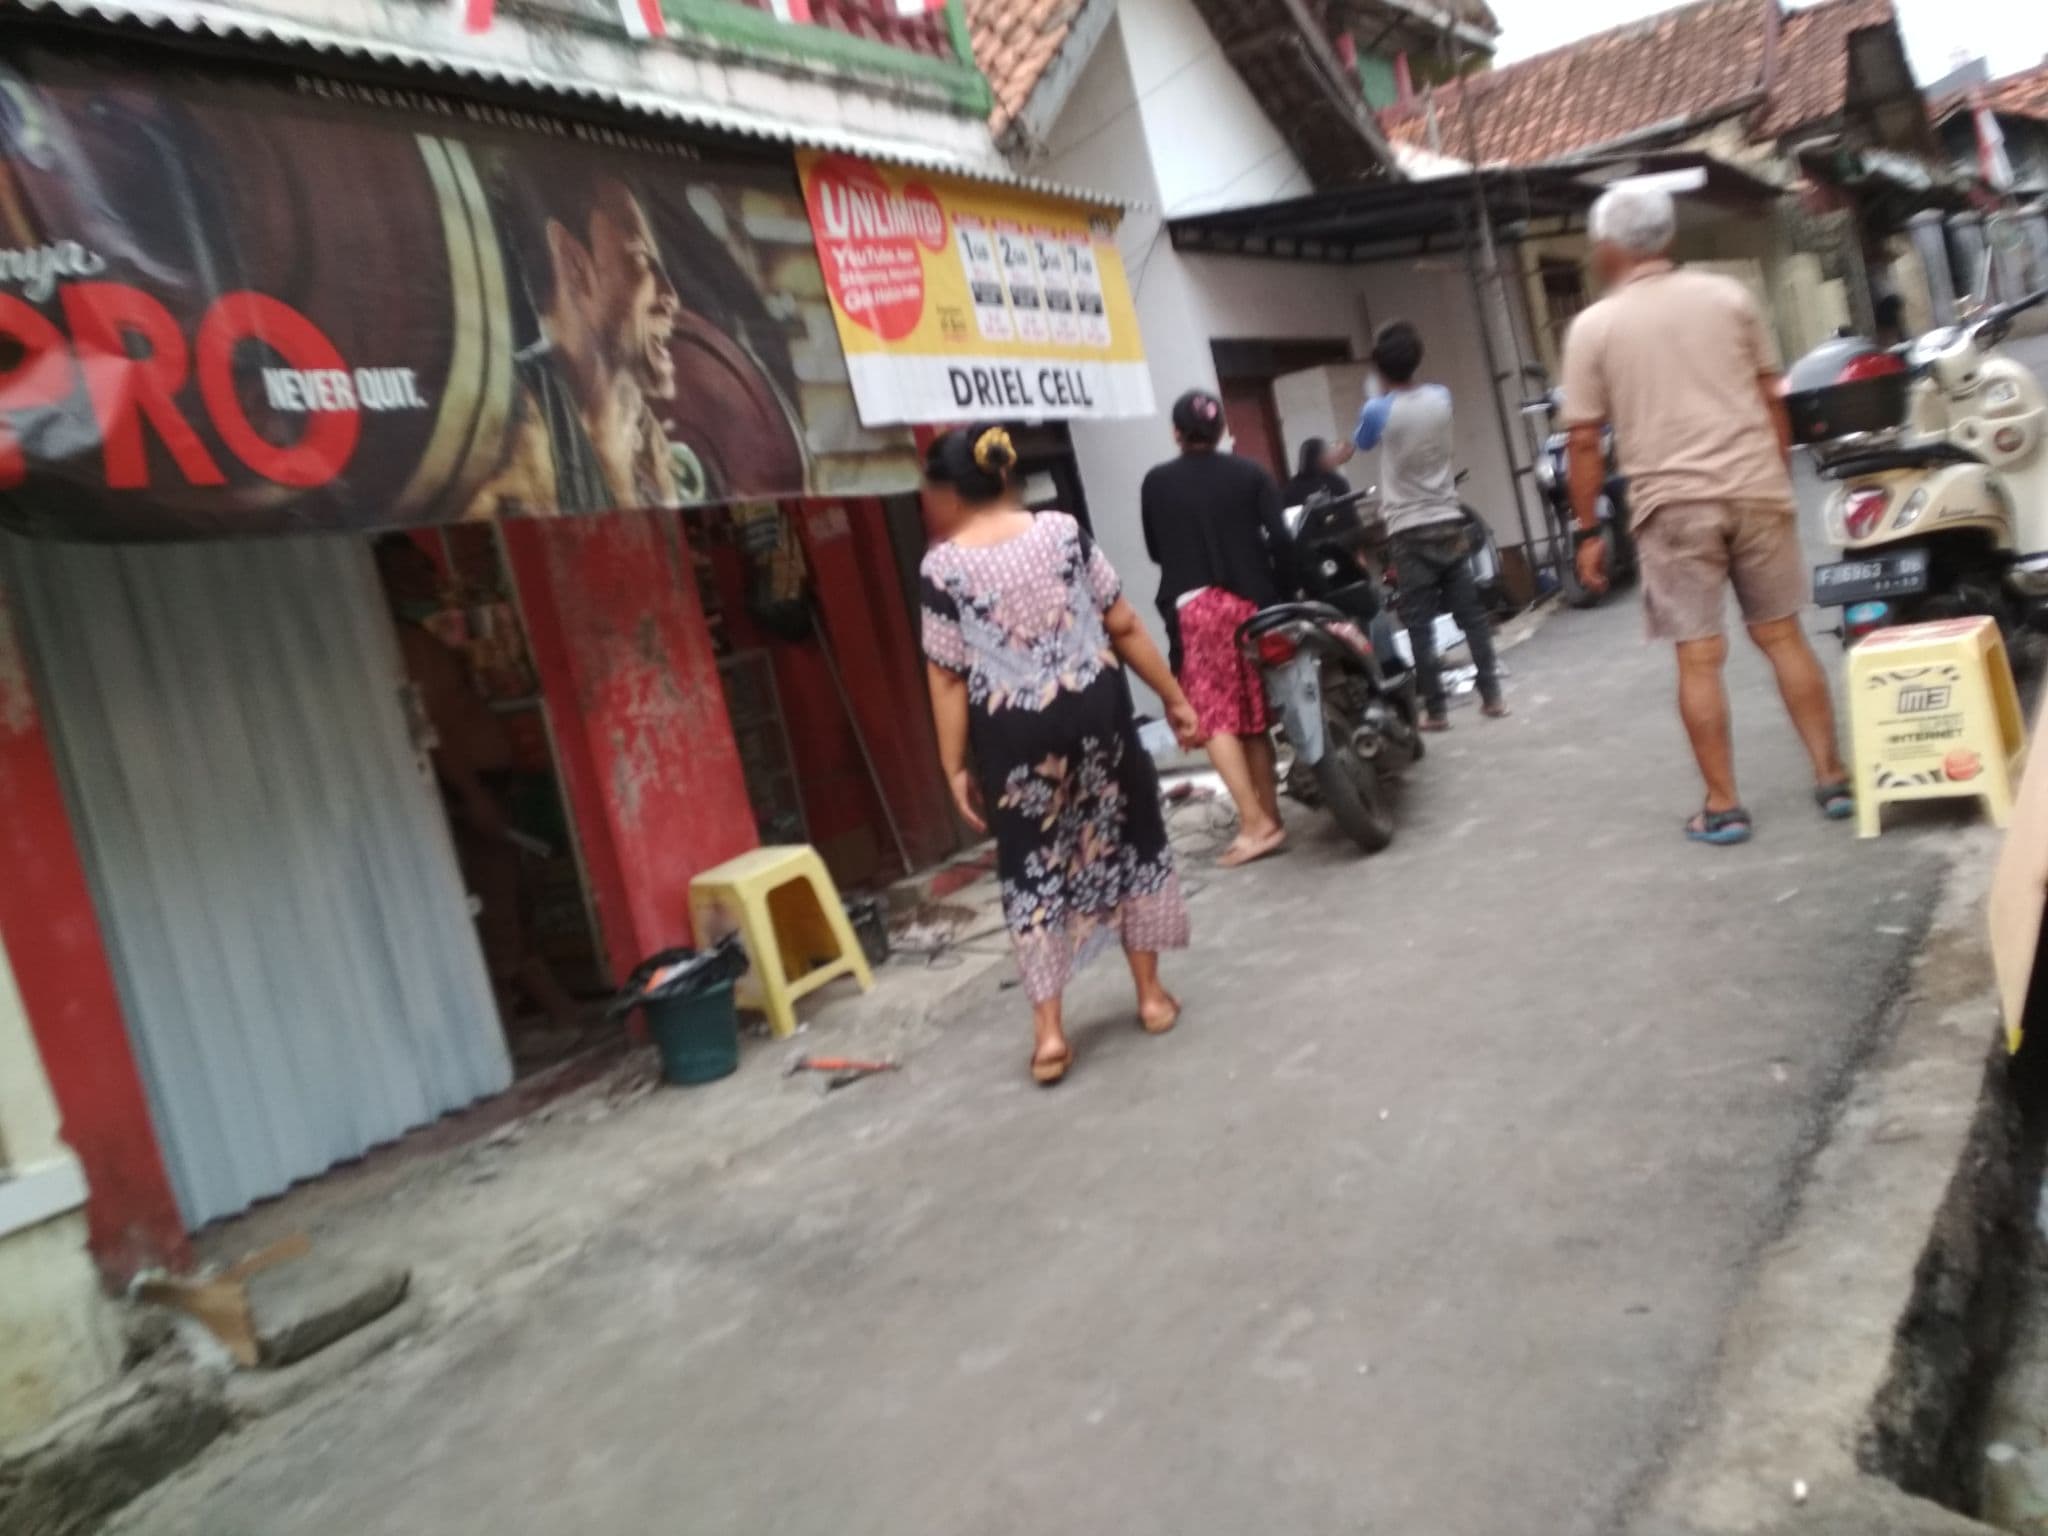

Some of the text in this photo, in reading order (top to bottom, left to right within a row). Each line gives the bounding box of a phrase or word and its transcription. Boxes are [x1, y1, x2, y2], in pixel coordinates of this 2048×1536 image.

[821, 180, 942, 239] UNLIMITED
[0, 282, 361, 488] PRO
[262, 366, 429, 411] NEVER QUIT.
[948, 367, 1094, 407] DRIEL CELL
